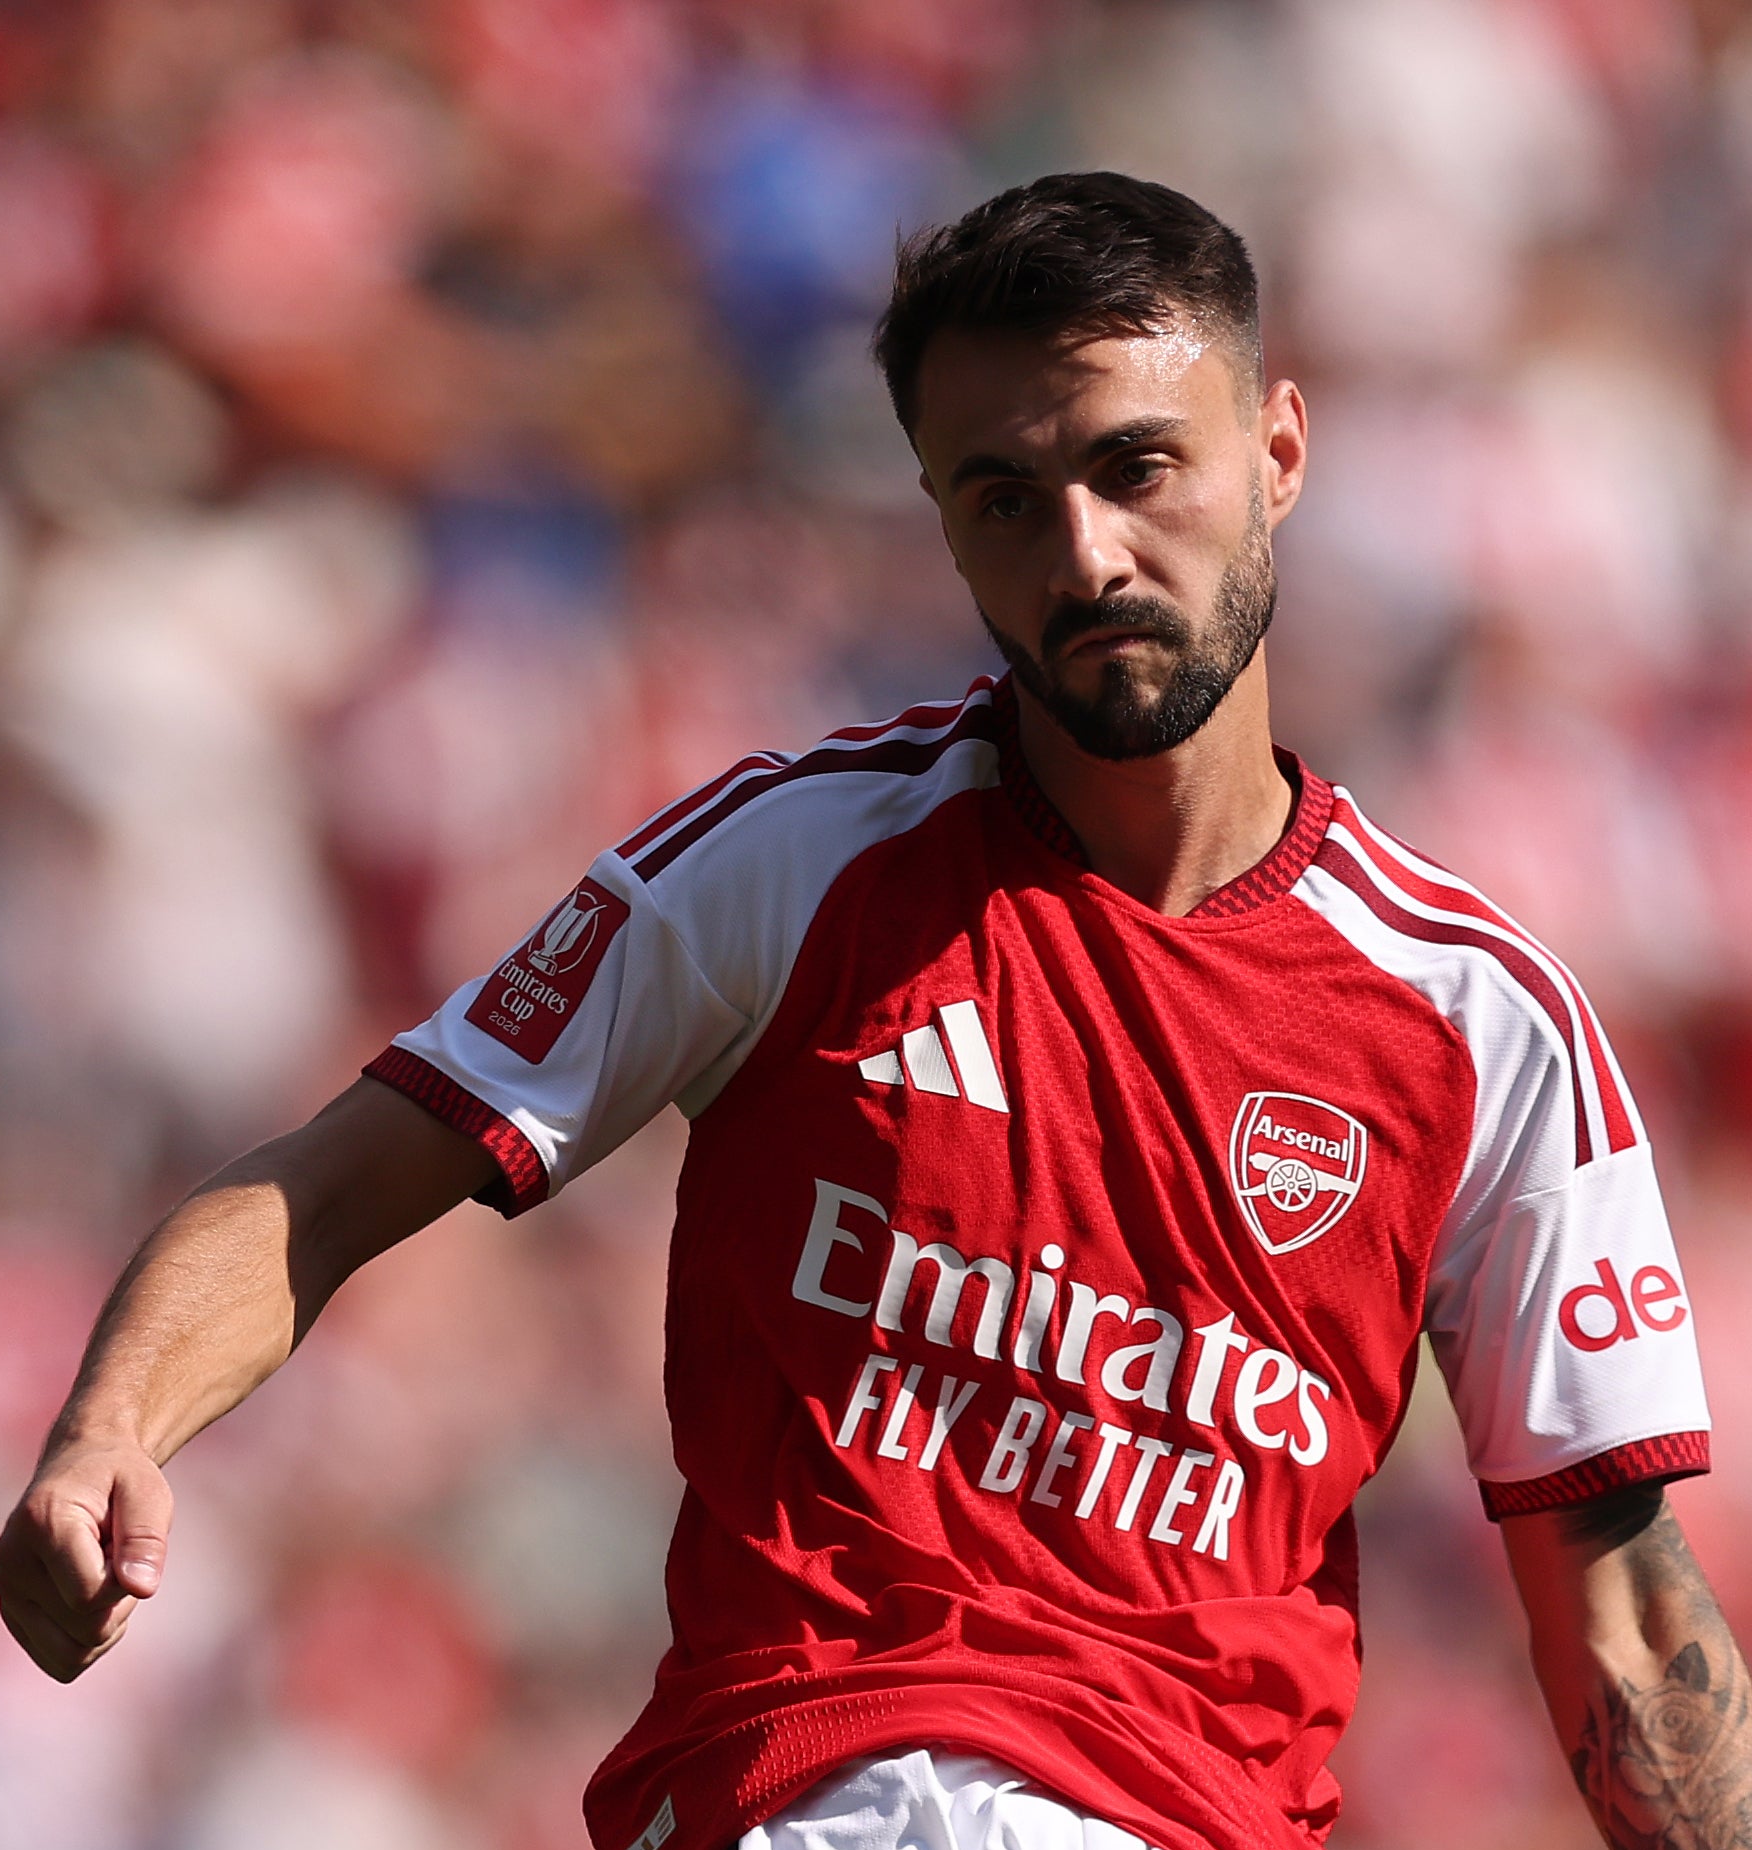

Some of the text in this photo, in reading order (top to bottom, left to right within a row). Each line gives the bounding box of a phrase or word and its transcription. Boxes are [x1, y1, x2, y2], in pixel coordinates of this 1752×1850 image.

[498, 957, 569, 1014] Emirates
[500, 987, 535, 1022] Cup
[488, 1010, 521, 1036] 2026
[1252, 1115, 1349, 1162] Arsenal
[791, 1177, 1330, 1467] Emirates
[835, 1353, 1246, 1562] FLY BETTER
